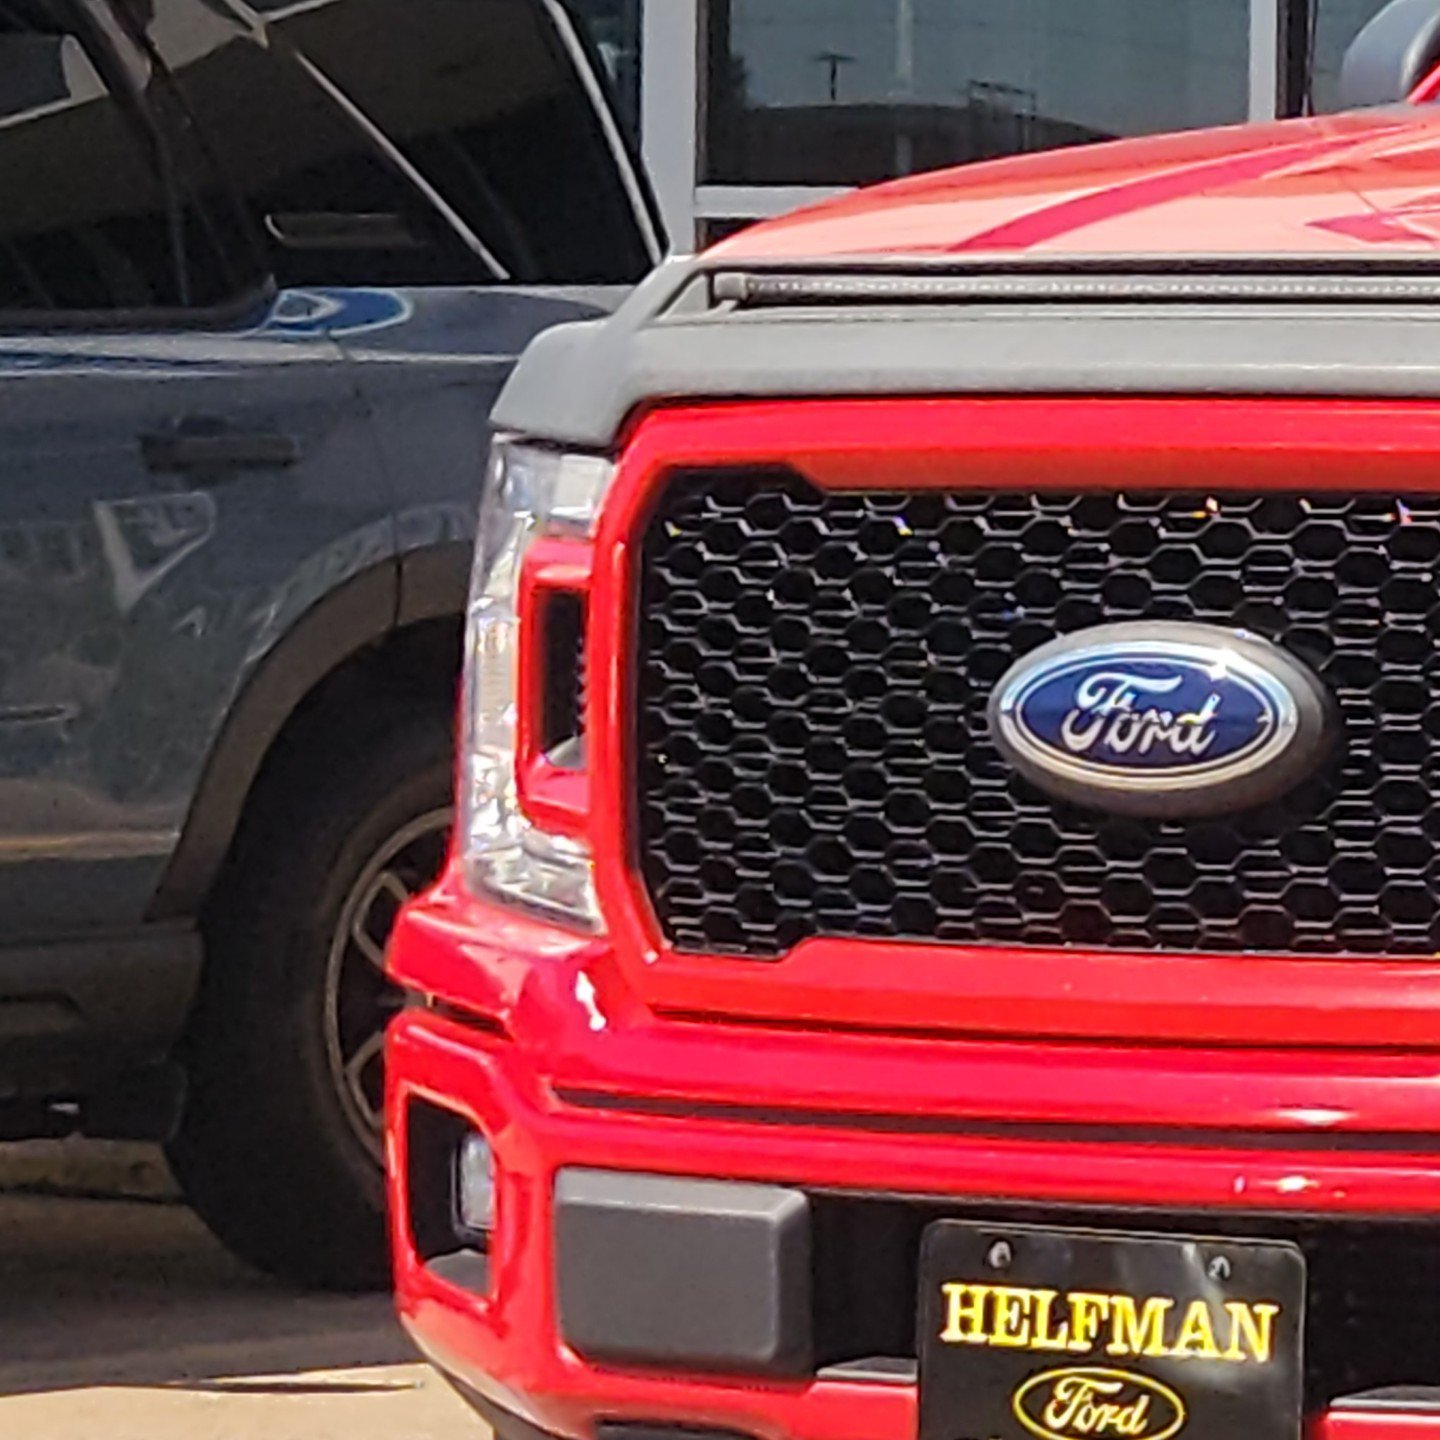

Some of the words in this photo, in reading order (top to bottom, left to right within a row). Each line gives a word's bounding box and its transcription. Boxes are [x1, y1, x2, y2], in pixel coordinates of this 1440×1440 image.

[1061, 671, 1222, 756] Ford
[938, 1281, 1280, 1363] HELFMAN
[1044, 1376, 1151, 1436] Ford
